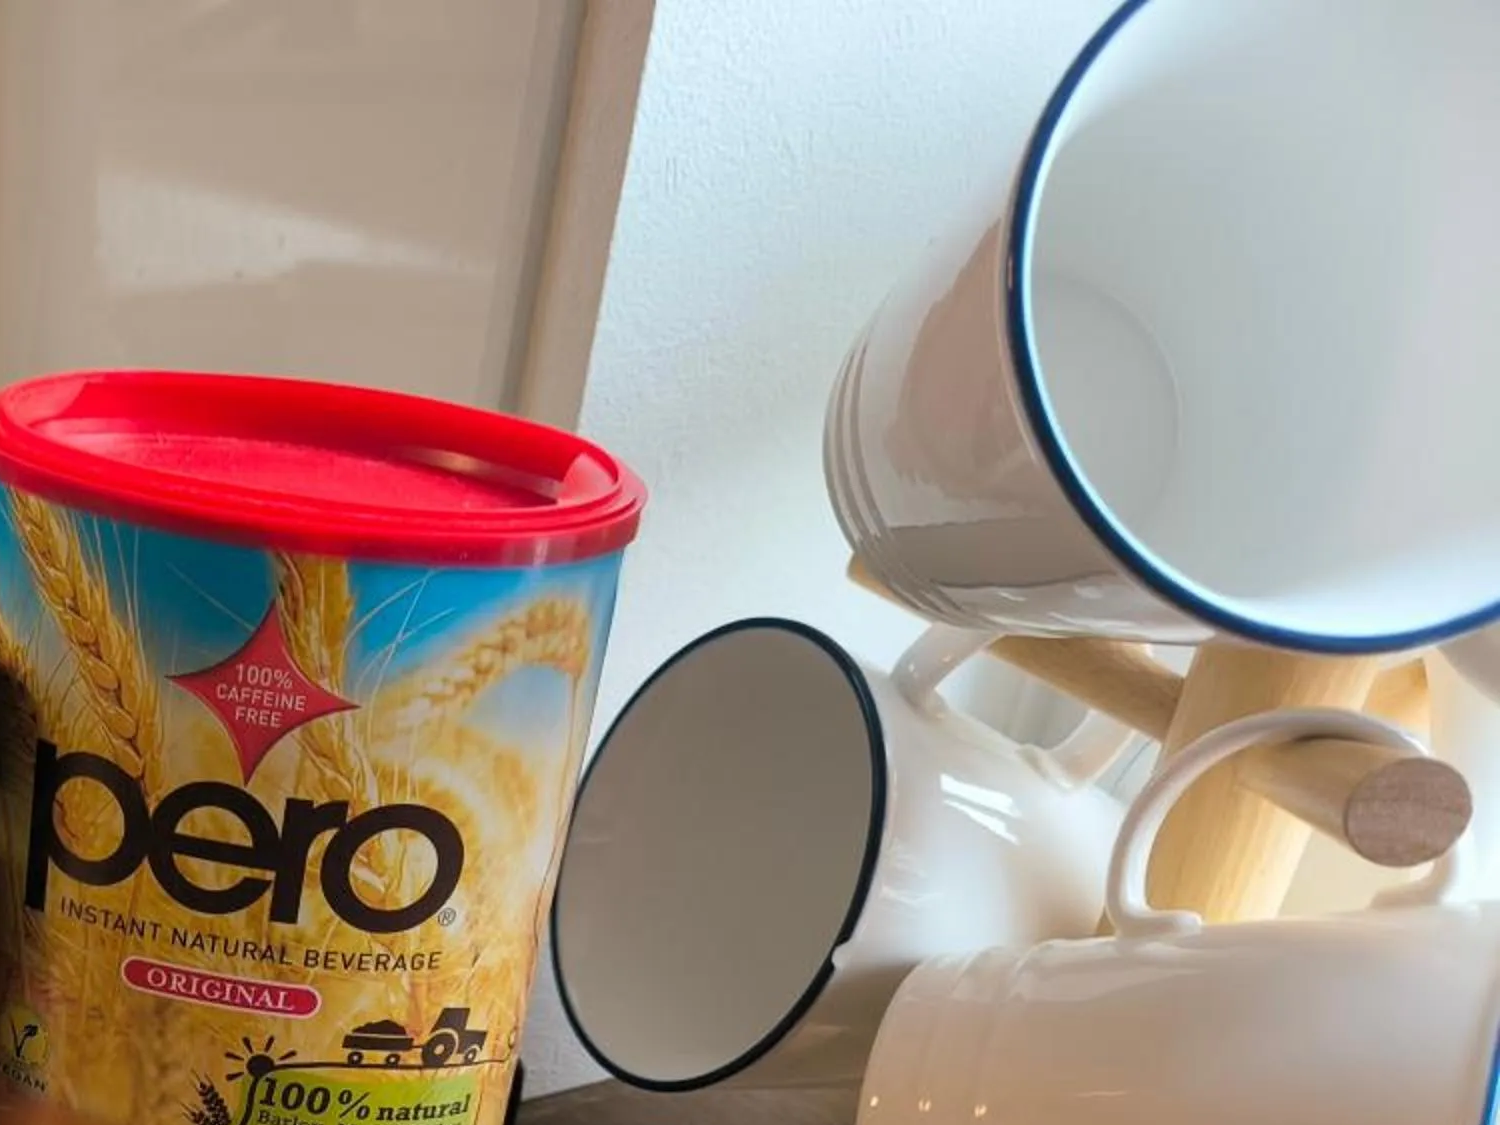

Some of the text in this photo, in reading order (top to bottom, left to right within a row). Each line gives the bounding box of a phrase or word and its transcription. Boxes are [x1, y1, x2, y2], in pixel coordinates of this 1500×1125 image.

[216, 683, 307, 713] CAFFEINE
[235, 662, 294, 690] 100%
[233, 707, 283, 729] FREE
[24, 739, 465, 935] pero
[59, 897, 444, 973] INSTANT NATURAL BEVERAGE
[145, 965, 298, 1013] ORIGINAL
[259, 1077, 472, 1122] 100% natural
